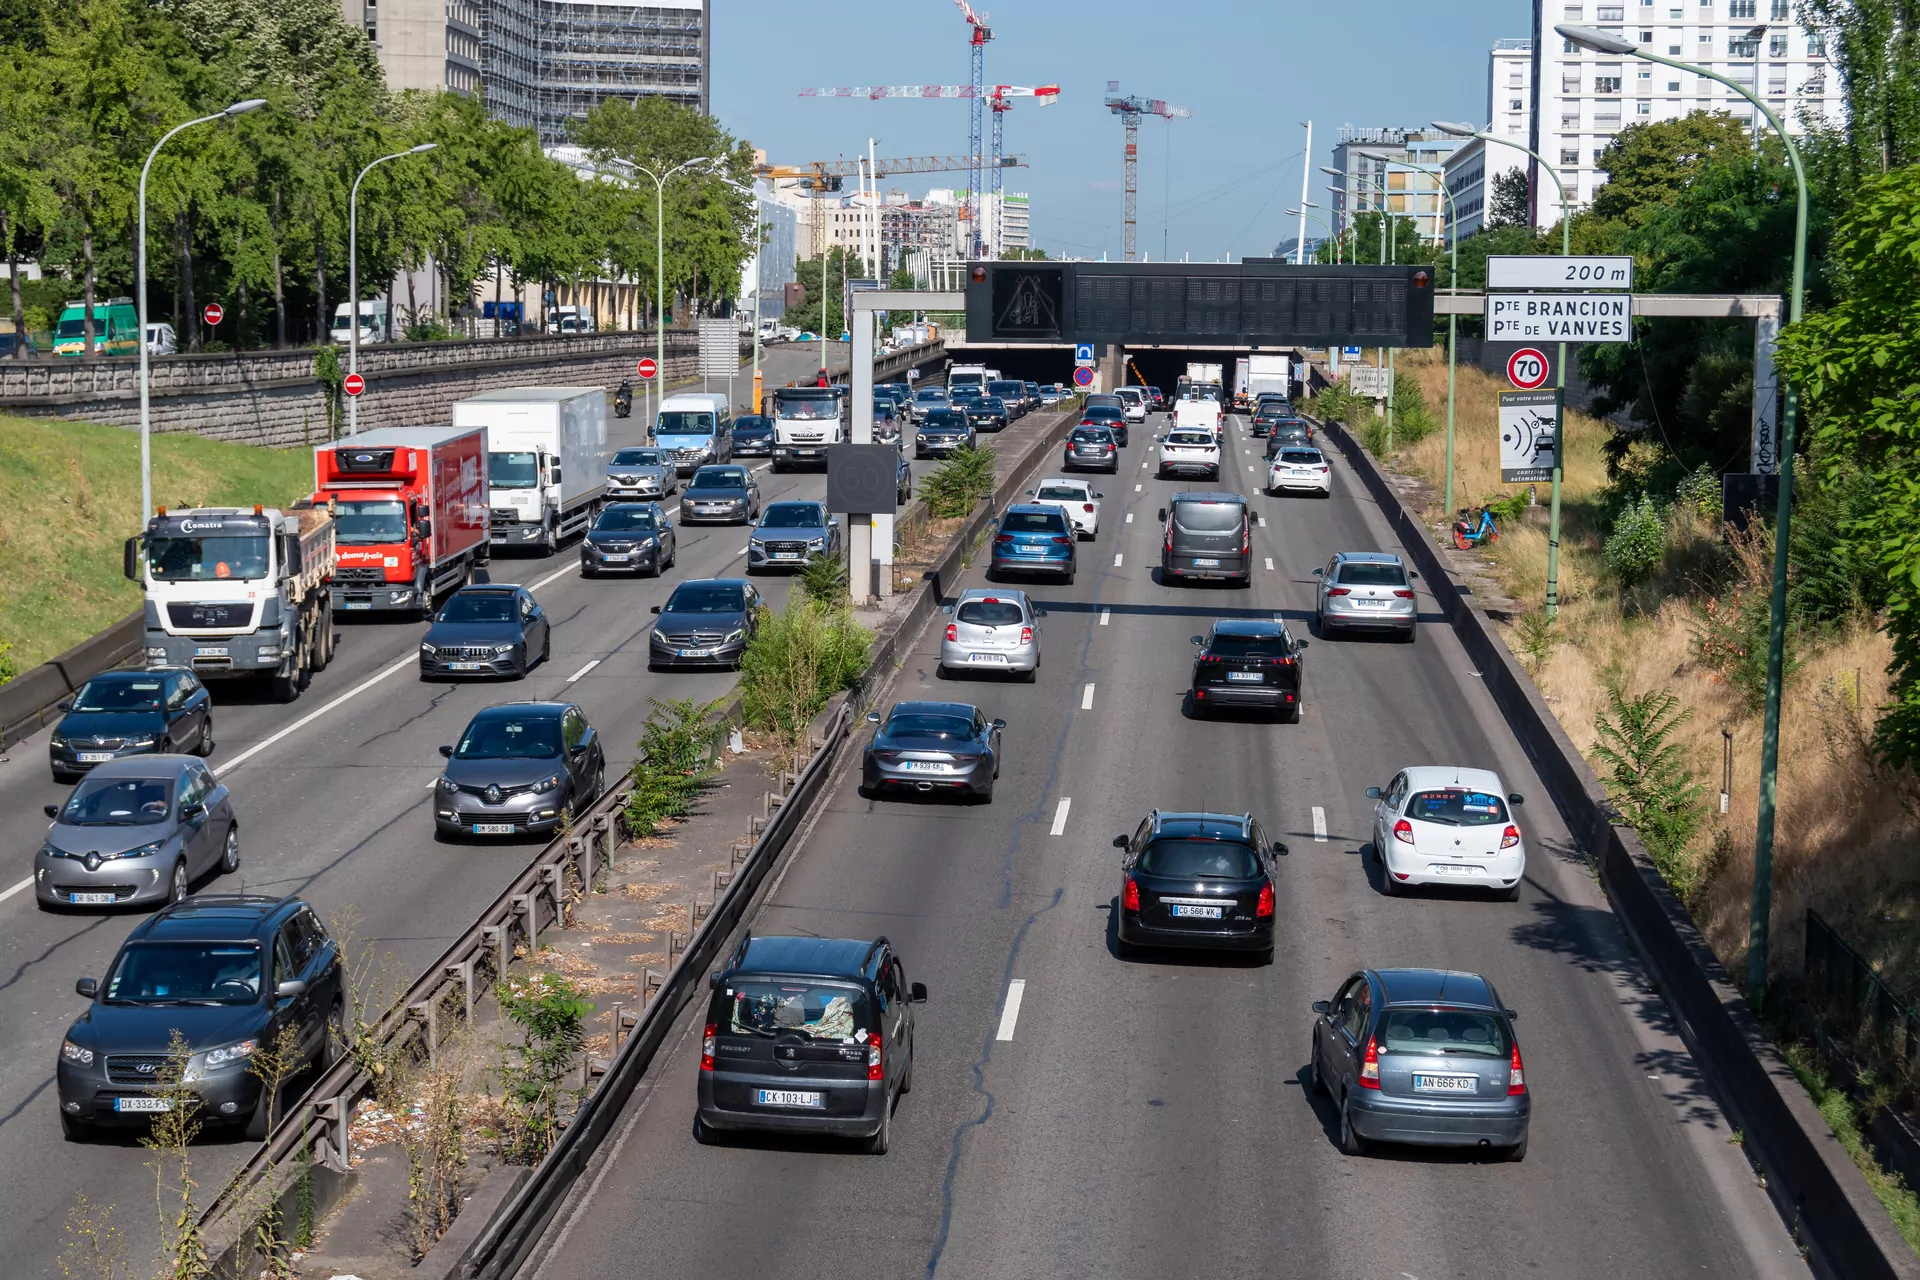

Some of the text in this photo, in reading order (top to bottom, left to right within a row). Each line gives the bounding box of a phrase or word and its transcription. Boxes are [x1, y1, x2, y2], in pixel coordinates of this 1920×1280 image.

[1565, 265, 1625, 281] 200 m
[1494, 301, 1623, 316] PTE BRANCION
[1494, 320, 1623, 336] PTE DE VANVES
[1517, 360, 1540, 377] 70
[1178, 907, 1216, 916] CG-566-VK
[1422, 1078, 1469, 1089] AN-666-KD
[766, 1092, 812, 1104] CK-103-LJ
